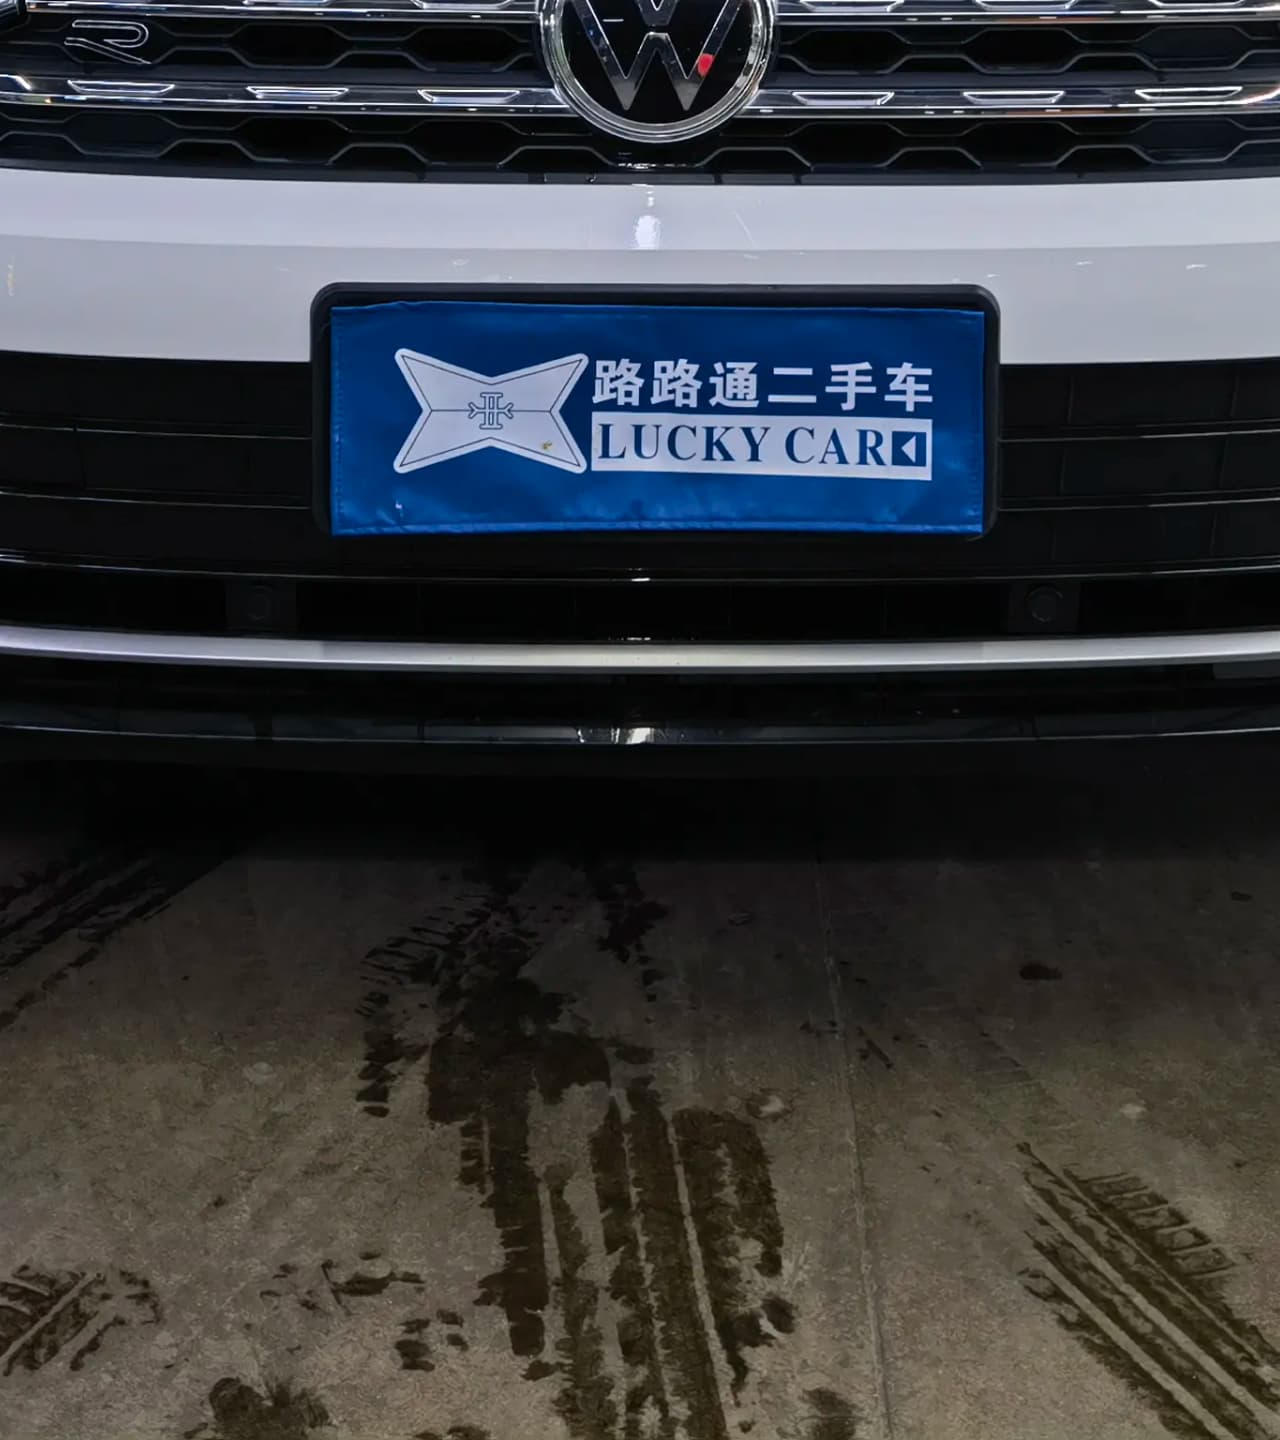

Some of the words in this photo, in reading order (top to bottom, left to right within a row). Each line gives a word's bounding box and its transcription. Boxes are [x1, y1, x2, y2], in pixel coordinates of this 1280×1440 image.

[593, 359, 933, 412] 路路通二手车
[598, 423, 771, 462] LUCKY
[784, 426, 887, 467] CAR
